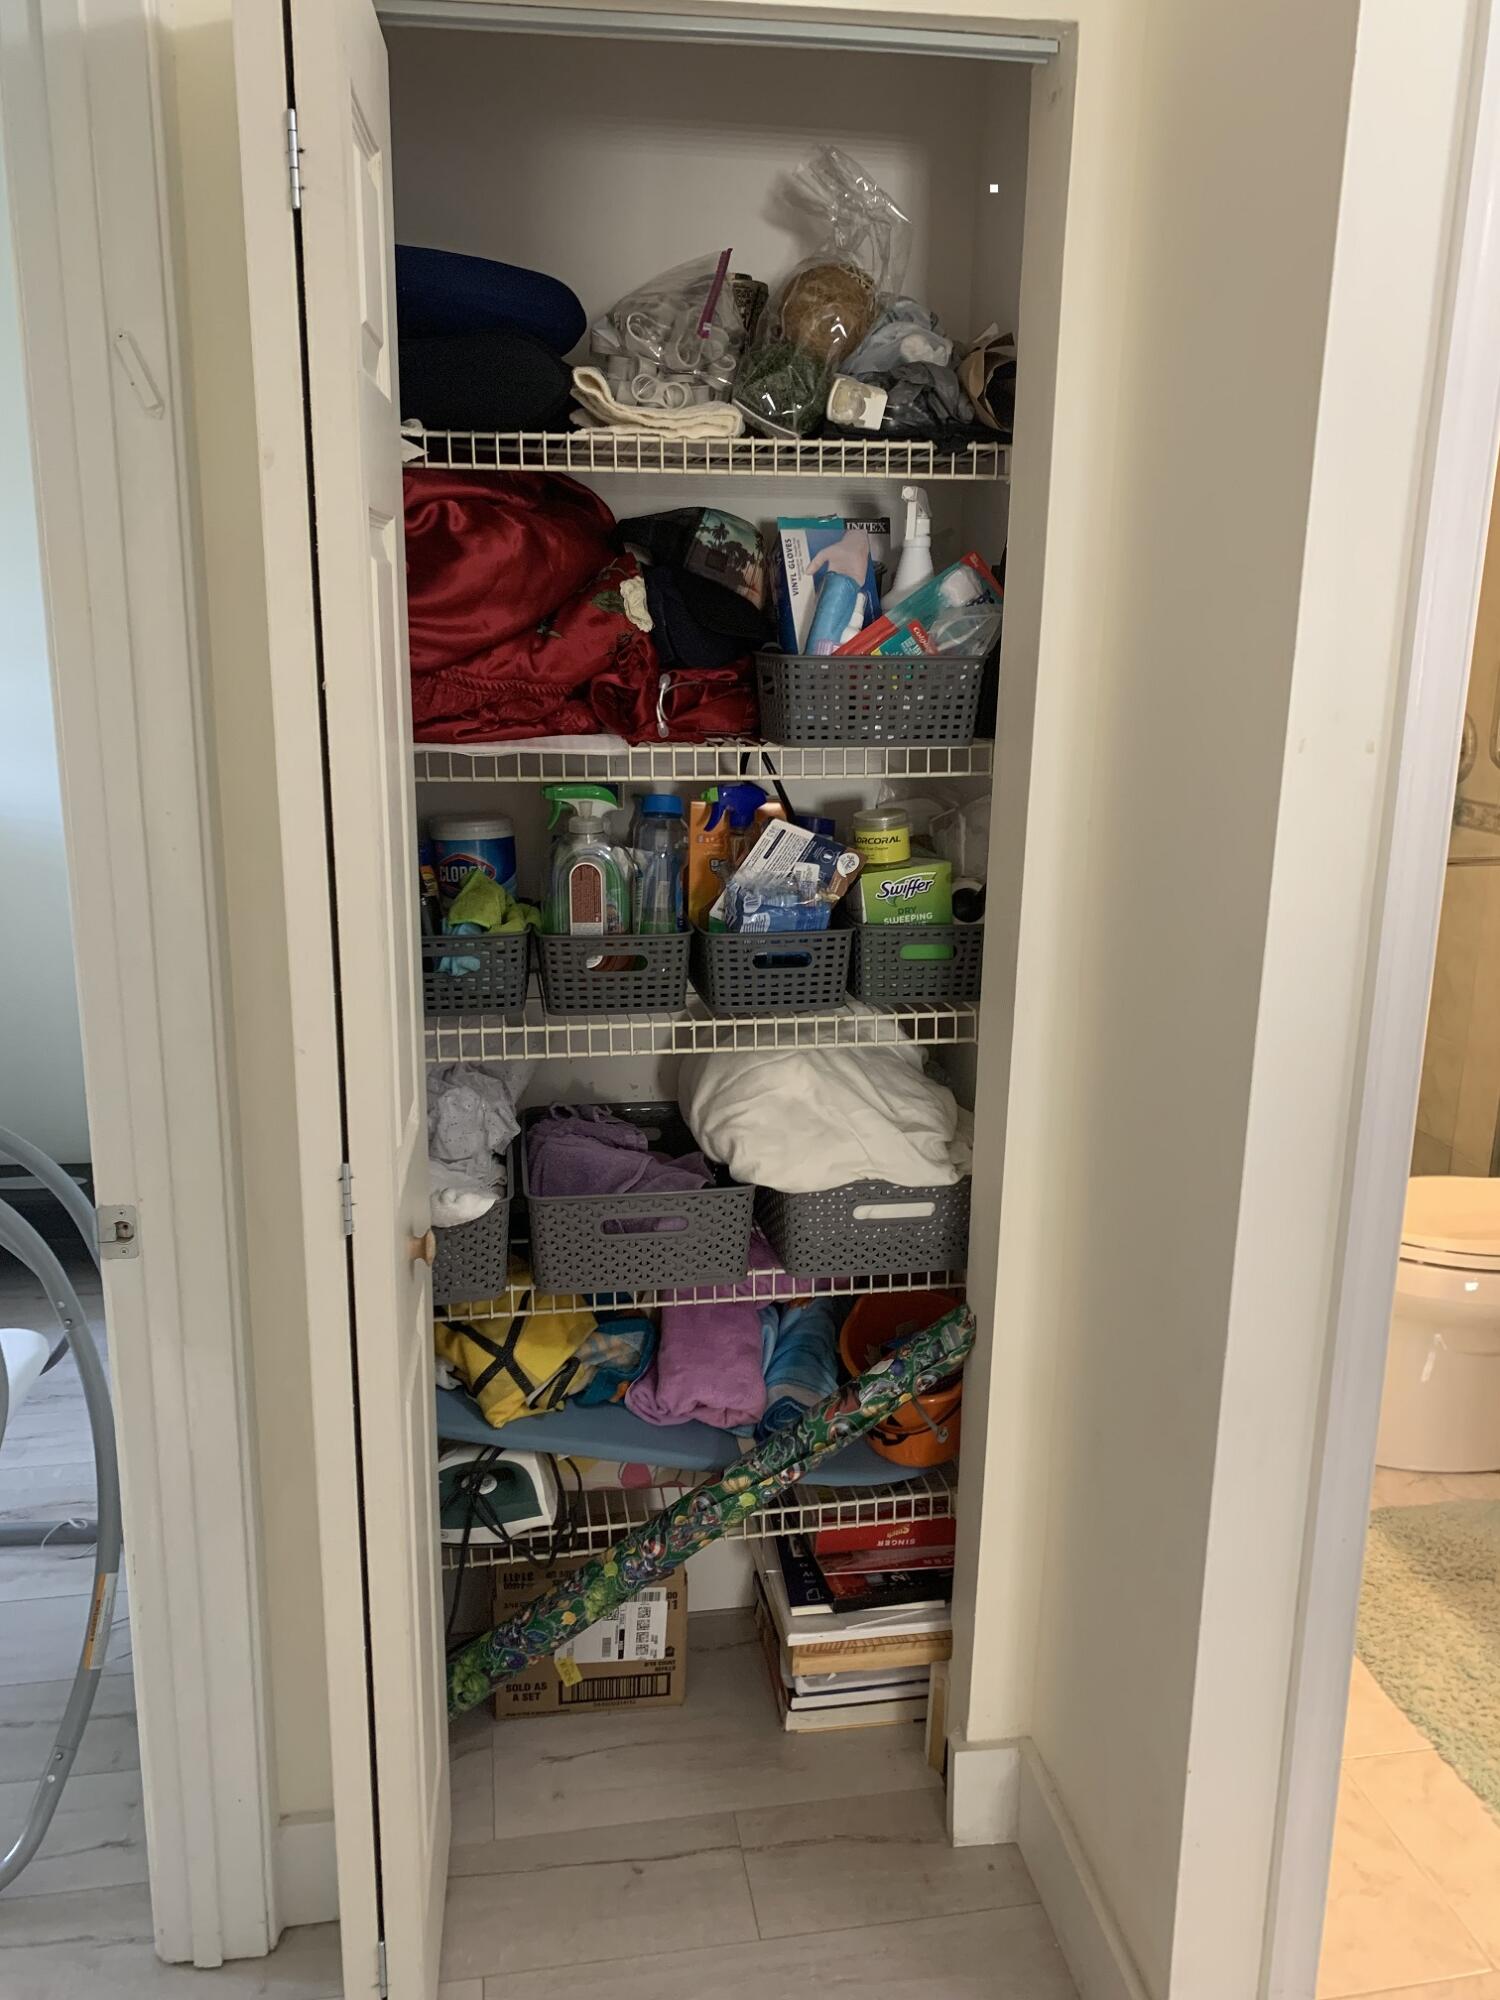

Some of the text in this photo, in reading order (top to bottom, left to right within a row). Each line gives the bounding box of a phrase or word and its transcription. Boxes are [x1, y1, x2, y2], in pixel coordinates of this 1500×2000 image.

[846, 522, 886, 532] INTEX
[784, 538, 800, 597] VINYL GLOVES
[439, 865, 486, 882] CLOR
[876, 877, 934, 900] Swiffer
[898, 906, 917, 915] DRY
[884, 912, 933, 924] SWEEPING
[876, 1538, 916, 1546] SINGER
[505, 1682, 548, 1693] SOLD AS
[512, 1692, 541, 1702] A SET
